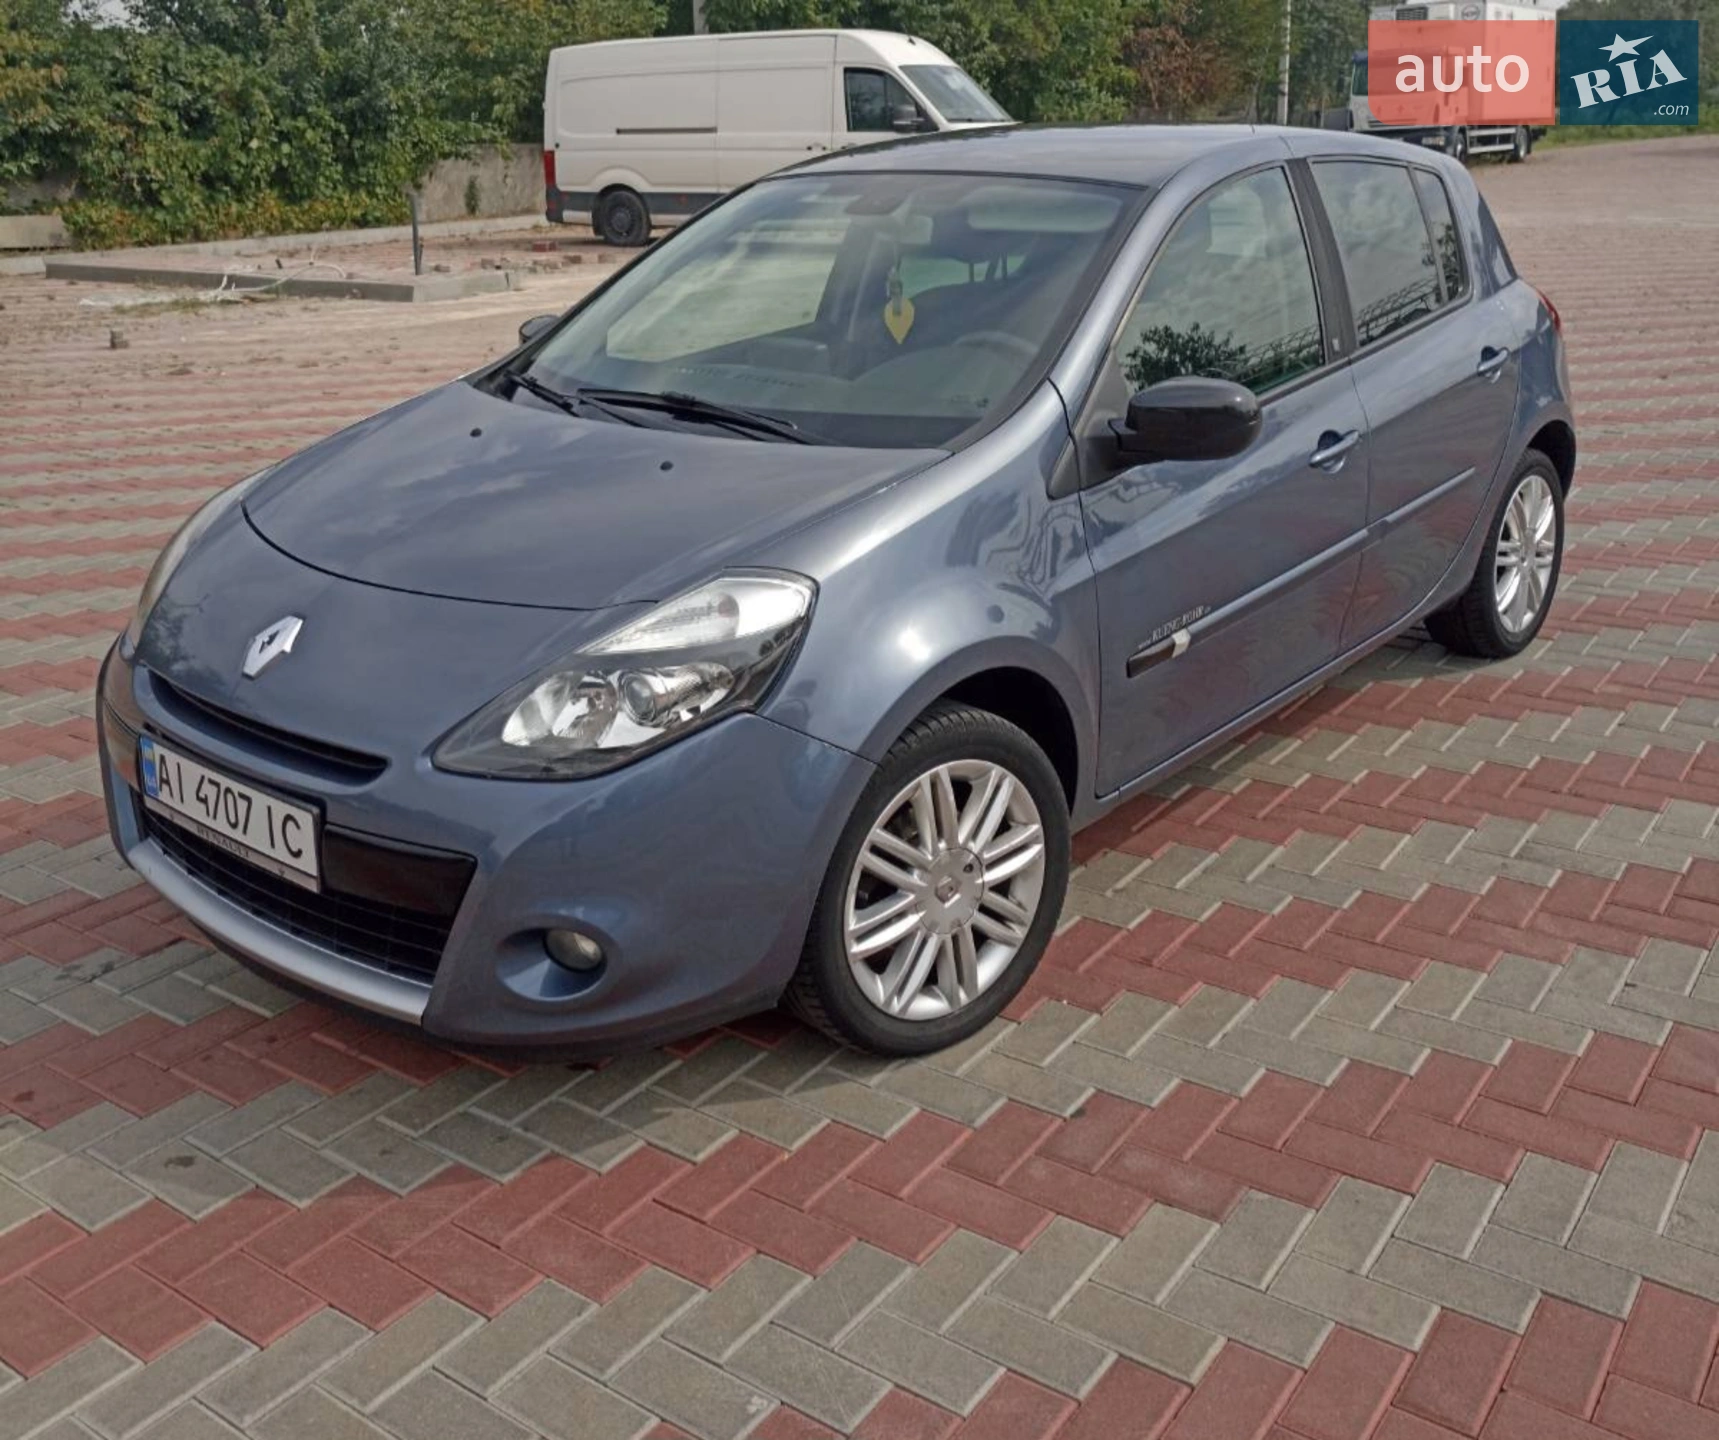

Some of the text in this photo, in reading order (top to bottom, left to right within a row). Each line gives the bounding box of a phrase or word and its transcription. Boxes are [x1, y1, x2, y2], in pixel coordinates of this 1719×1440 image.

[159, 753, 303, 858] AI 4707 IC
